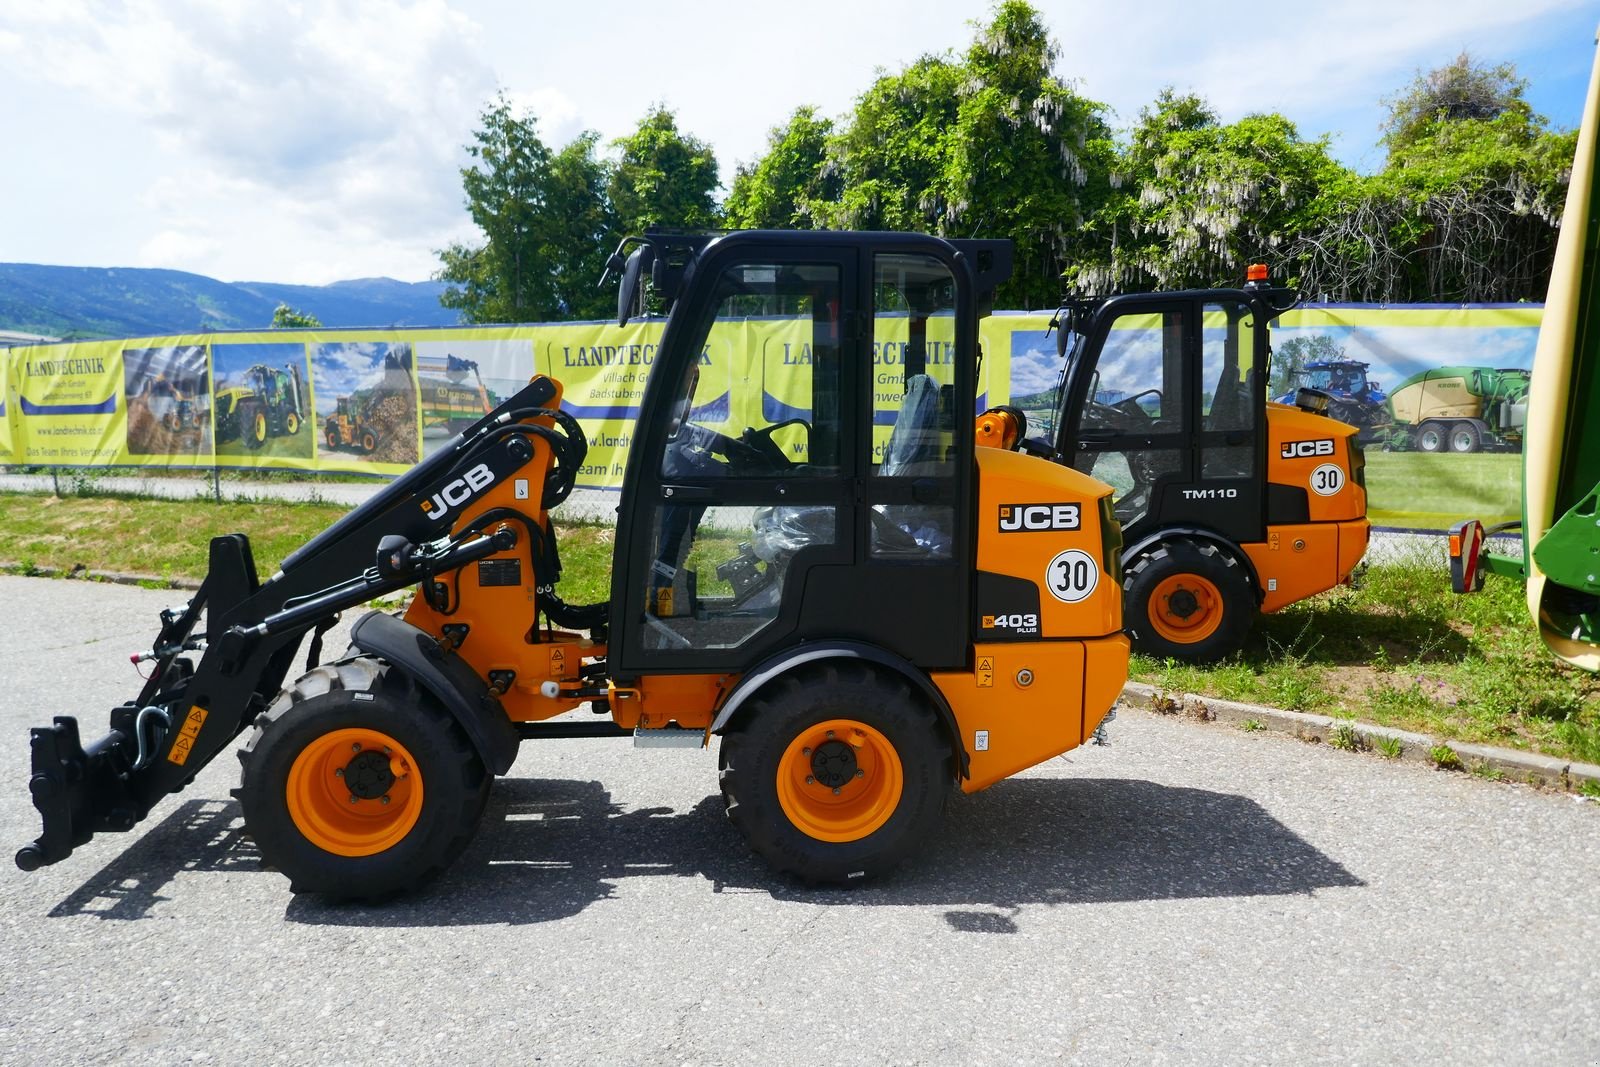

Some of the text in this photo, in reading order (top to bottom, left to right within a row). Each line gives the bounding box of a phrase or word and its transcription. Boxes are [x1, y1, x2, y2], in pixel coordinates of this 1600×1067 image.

[563, 344, 712, 367] LANDTECK
[26, 358, 105, 376] LANDTECHNIK
[603, 372, 635, 383] Villach
[877, 372, 906, 385] Gmb
[26, 447, 40, 456] Das
[41, 447, 59, 456] Team
[1281, 440, 1334, 458] JCB
[577, 463, 623, 476] eam Ih
[1316, 470, 1338, 489] 30
[426, 463, 495, 520] JCB
[1182, 488, 1237, 499] TM110
[1000, 505, 1080, 530] JCB
[1056, 560, 1088, 591] 30
[994, 613, 1037, 628] 403
